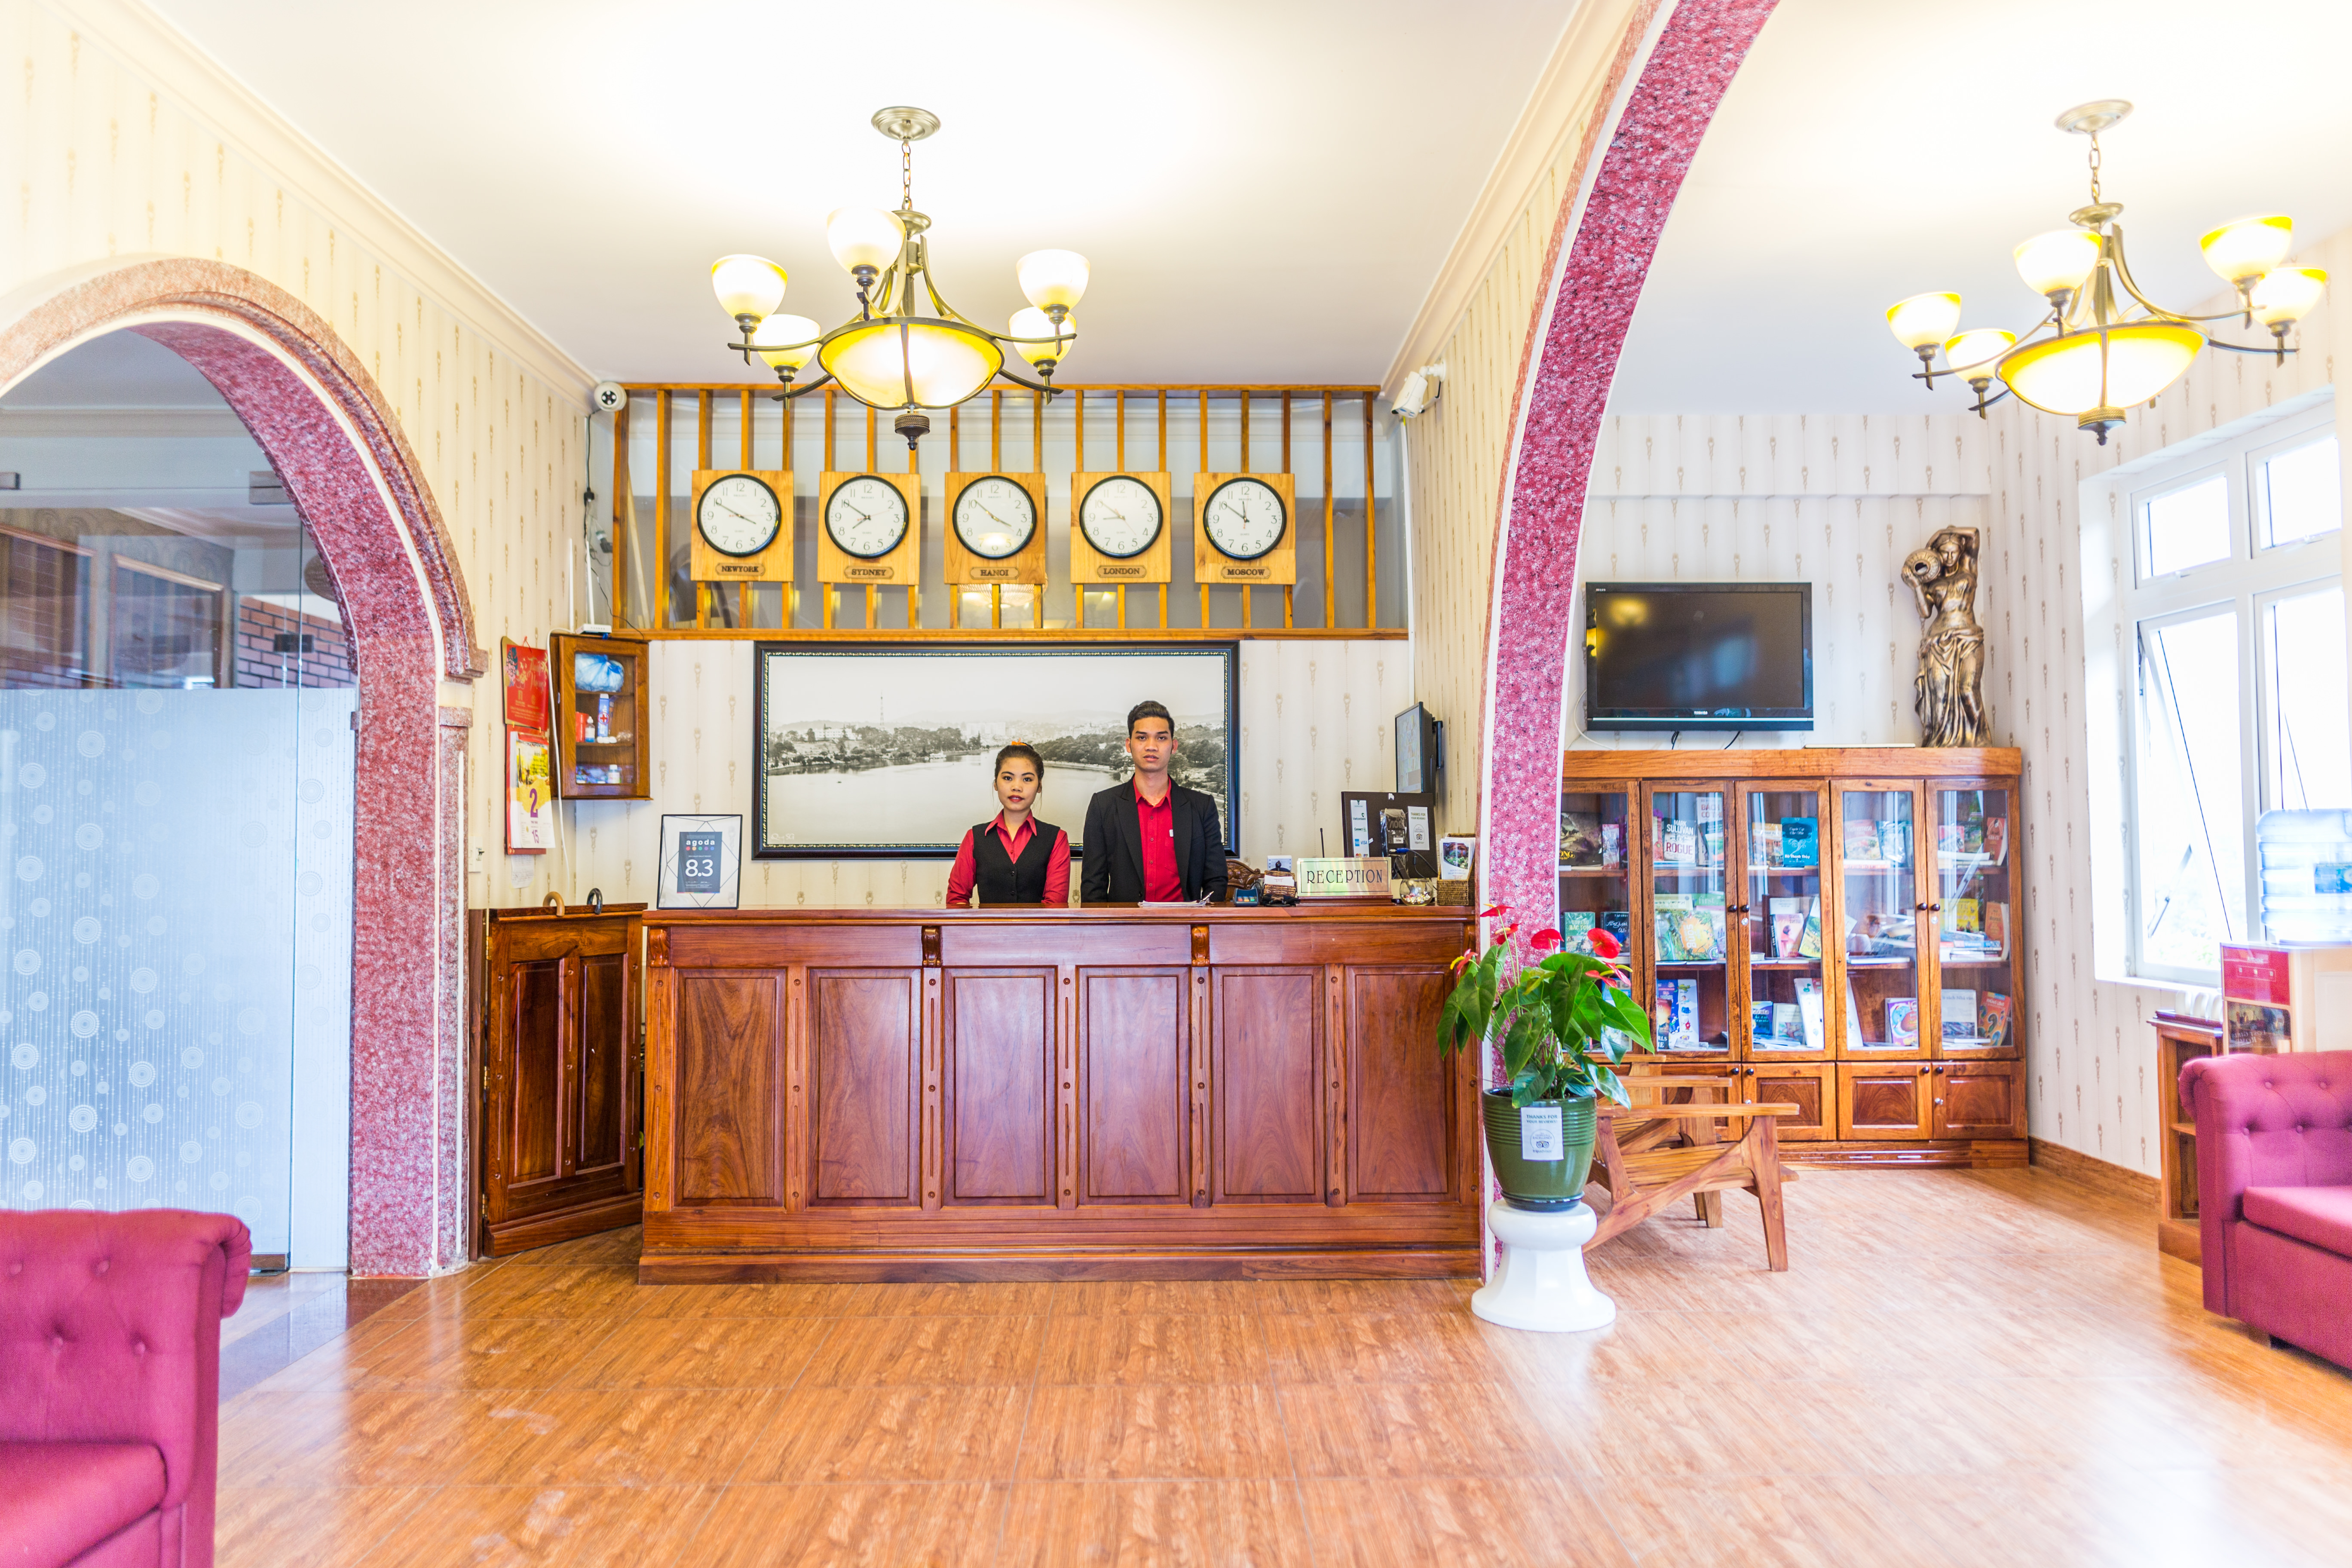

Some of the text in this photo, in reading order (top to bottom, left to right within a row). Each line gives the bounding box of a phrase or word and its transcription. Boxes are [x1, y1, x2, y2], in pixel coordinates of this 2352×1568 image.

[723, 487, 728, 496] 11
[737, 483, 745, 492] 12
[864, 484, 872, 493] 12
[991, 485, 999, 493] 12
[1118, 484, 1125, 493] 12
[1242, 487, 1250, 495] 12
[851, 489, 855, 497] 11
[977, 489, 982, 498] 11
[1104, 489, 1109, 497] 11
[1228, 491, 1233, 499] 11
[714, 497, 722, 506] 10
[760, 499, 766, 507] 2
[841, 499, 849, 508] 10
[888, 500, 894, 508] 2
[968, 499, 977, 509] 10
[1015, 500, 1021, 508] 2
[1095, 499, 1103, 508] 10
[1141, 499, 1147, 508] 2
[1219, 501, 1227, 510] 10
[1265, 502, 1271, 510] 2
[707, 511, 714, 520] 9
[766, 513, 772, 521] 3
[835, 513, 841, 521] 9
[894, 514, 900, 523] 3
[963, 514, 969, 522] 9
[1021, 514, 1027, 522] 3
[1089, 513, 1095, 522] 9
[1147, 514, 1153, 522] 3
[1213, 515, 1219, 523] 9
[1271, 515, 1277, 524] 3
[711, 526, 717, 534] 8
[839, 527, 845, 536] 8
[967, 528, 973, 536] 8
[1093, 527, 1099, 536] 8
[1142, 528, 1148, 536] 4
[1217, 529, 1222, 537] 8
[723, 536, 729, 545] 7
[736, 540, 742, 549] 6
[750, 537, 756, 546] 5
[850, 538, 856, 546] 7
[877, 539, 883, 548] 5
[1105, 538, 1110, 546] 7
[1132, 539, 1137, 547] 5
[1228, 539, 1234, 548] 7
[1256, 541, 1261, 549] 5
[864, 542, 870, 550] 6
[1118, 541, 1124, 550] 6
[1242, 543, 1248, 551] 6
[530, 788, 539, 818] 2
[1666, 824, 1694, 835] SULLIVAN
[532, 830, 539, 844] 15
[1666, 842, 1693, 855] ROGUE
[685, 859, 713, 877] 8.3
[1307, 870, 1382, 884] RECEPTION
